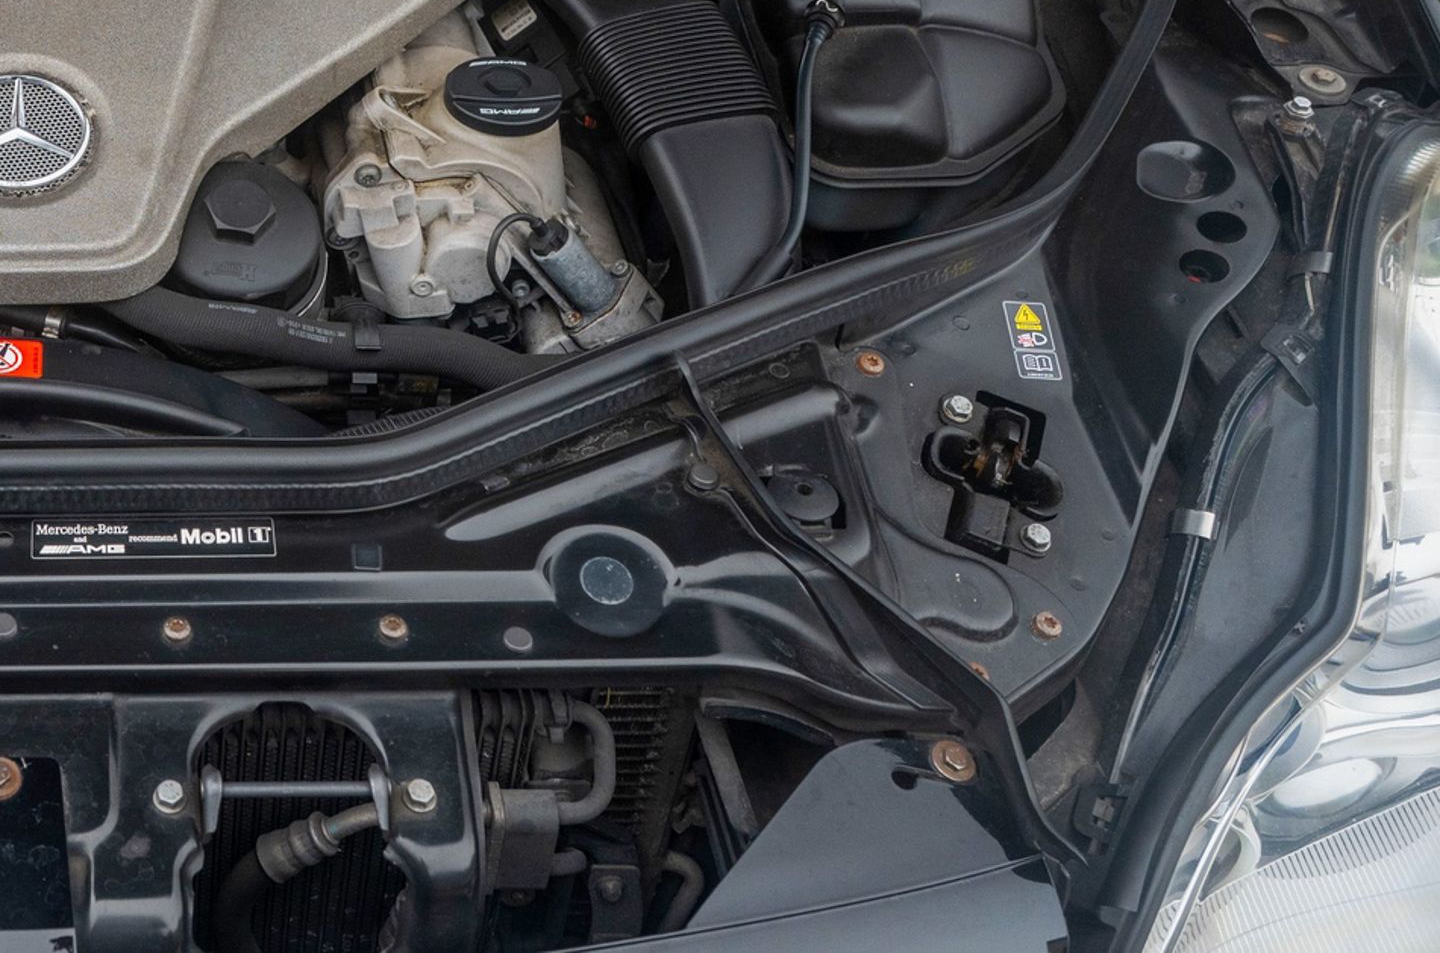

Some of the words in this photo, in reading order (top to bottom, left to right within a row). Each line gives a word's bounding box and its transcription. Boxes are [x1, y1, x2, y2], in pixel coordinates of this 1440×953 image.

[35, 524, 129, 535] Mercedes-Benz
[128, 534, 178, 543] recommend
[180, 528, 244, 545] Mobil
[66, 544, 126, 554] AMG
